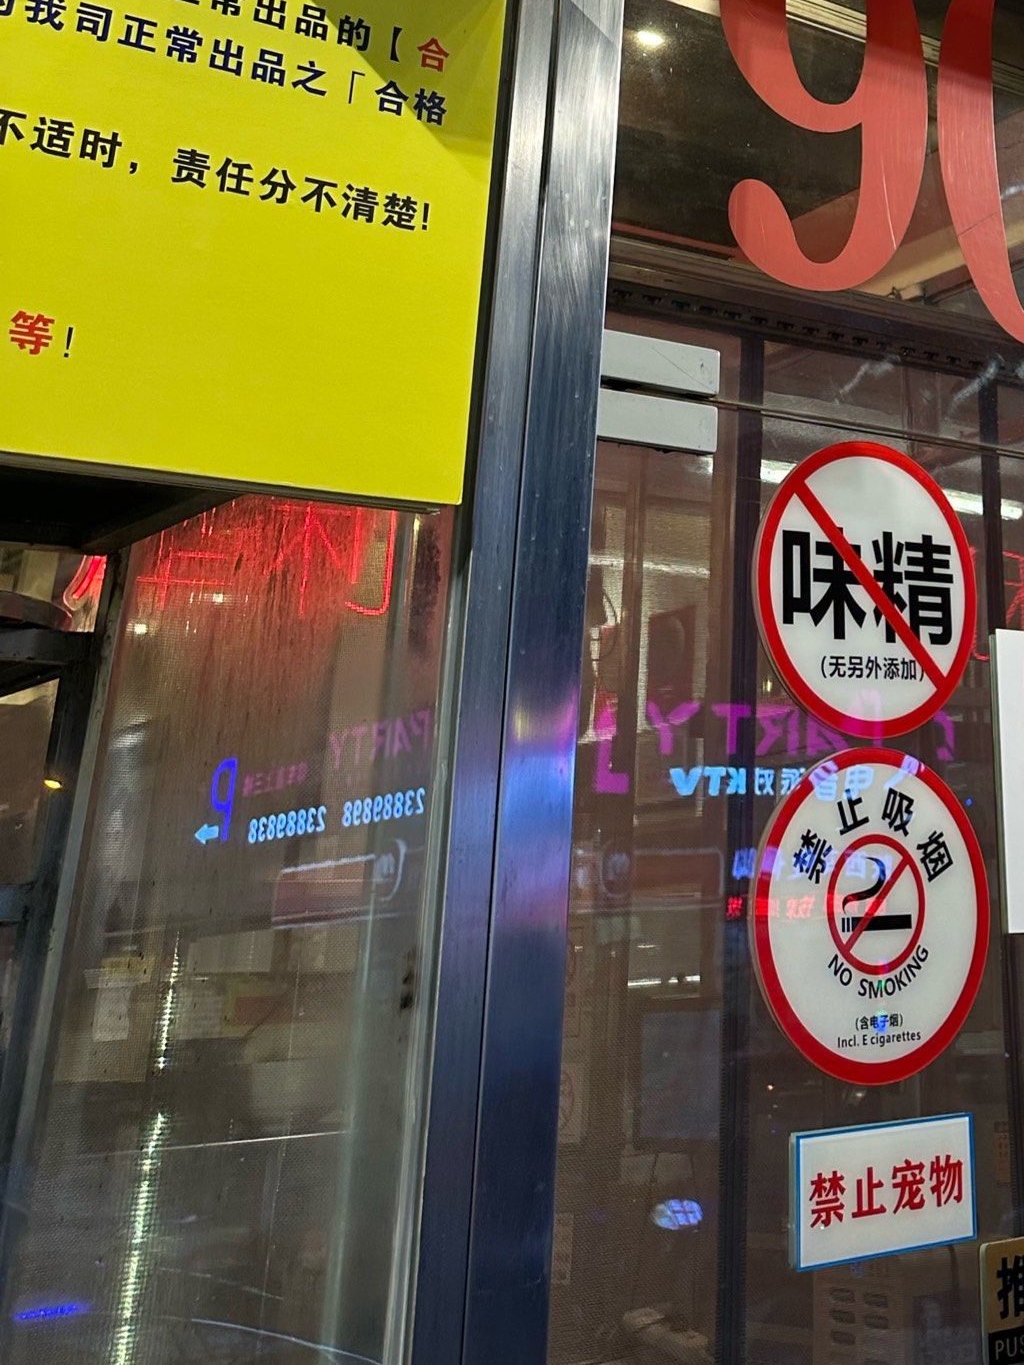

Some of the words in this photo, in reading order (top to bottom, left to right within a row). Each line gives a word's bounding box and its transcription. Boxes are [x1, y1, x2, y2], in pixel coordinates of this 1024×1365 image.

[782, 527, 954, 646] 味精
[821, 655, 925, 682] （无另外添加）
[793, 788, 953, 884] 禁止吸烟
[828, 954, 853, 986] NO
[857, 945, 929, 1000] SMOKING
[837, 1033, 860, 1049] Incl.
[862, 1034, 868, 1047] E
[870, 1031, 922, 1048] cigarettes
[855, 1012, 904, 1032] （含电子烟）
[809, 1154, 964, 1230] 禁止宠物
